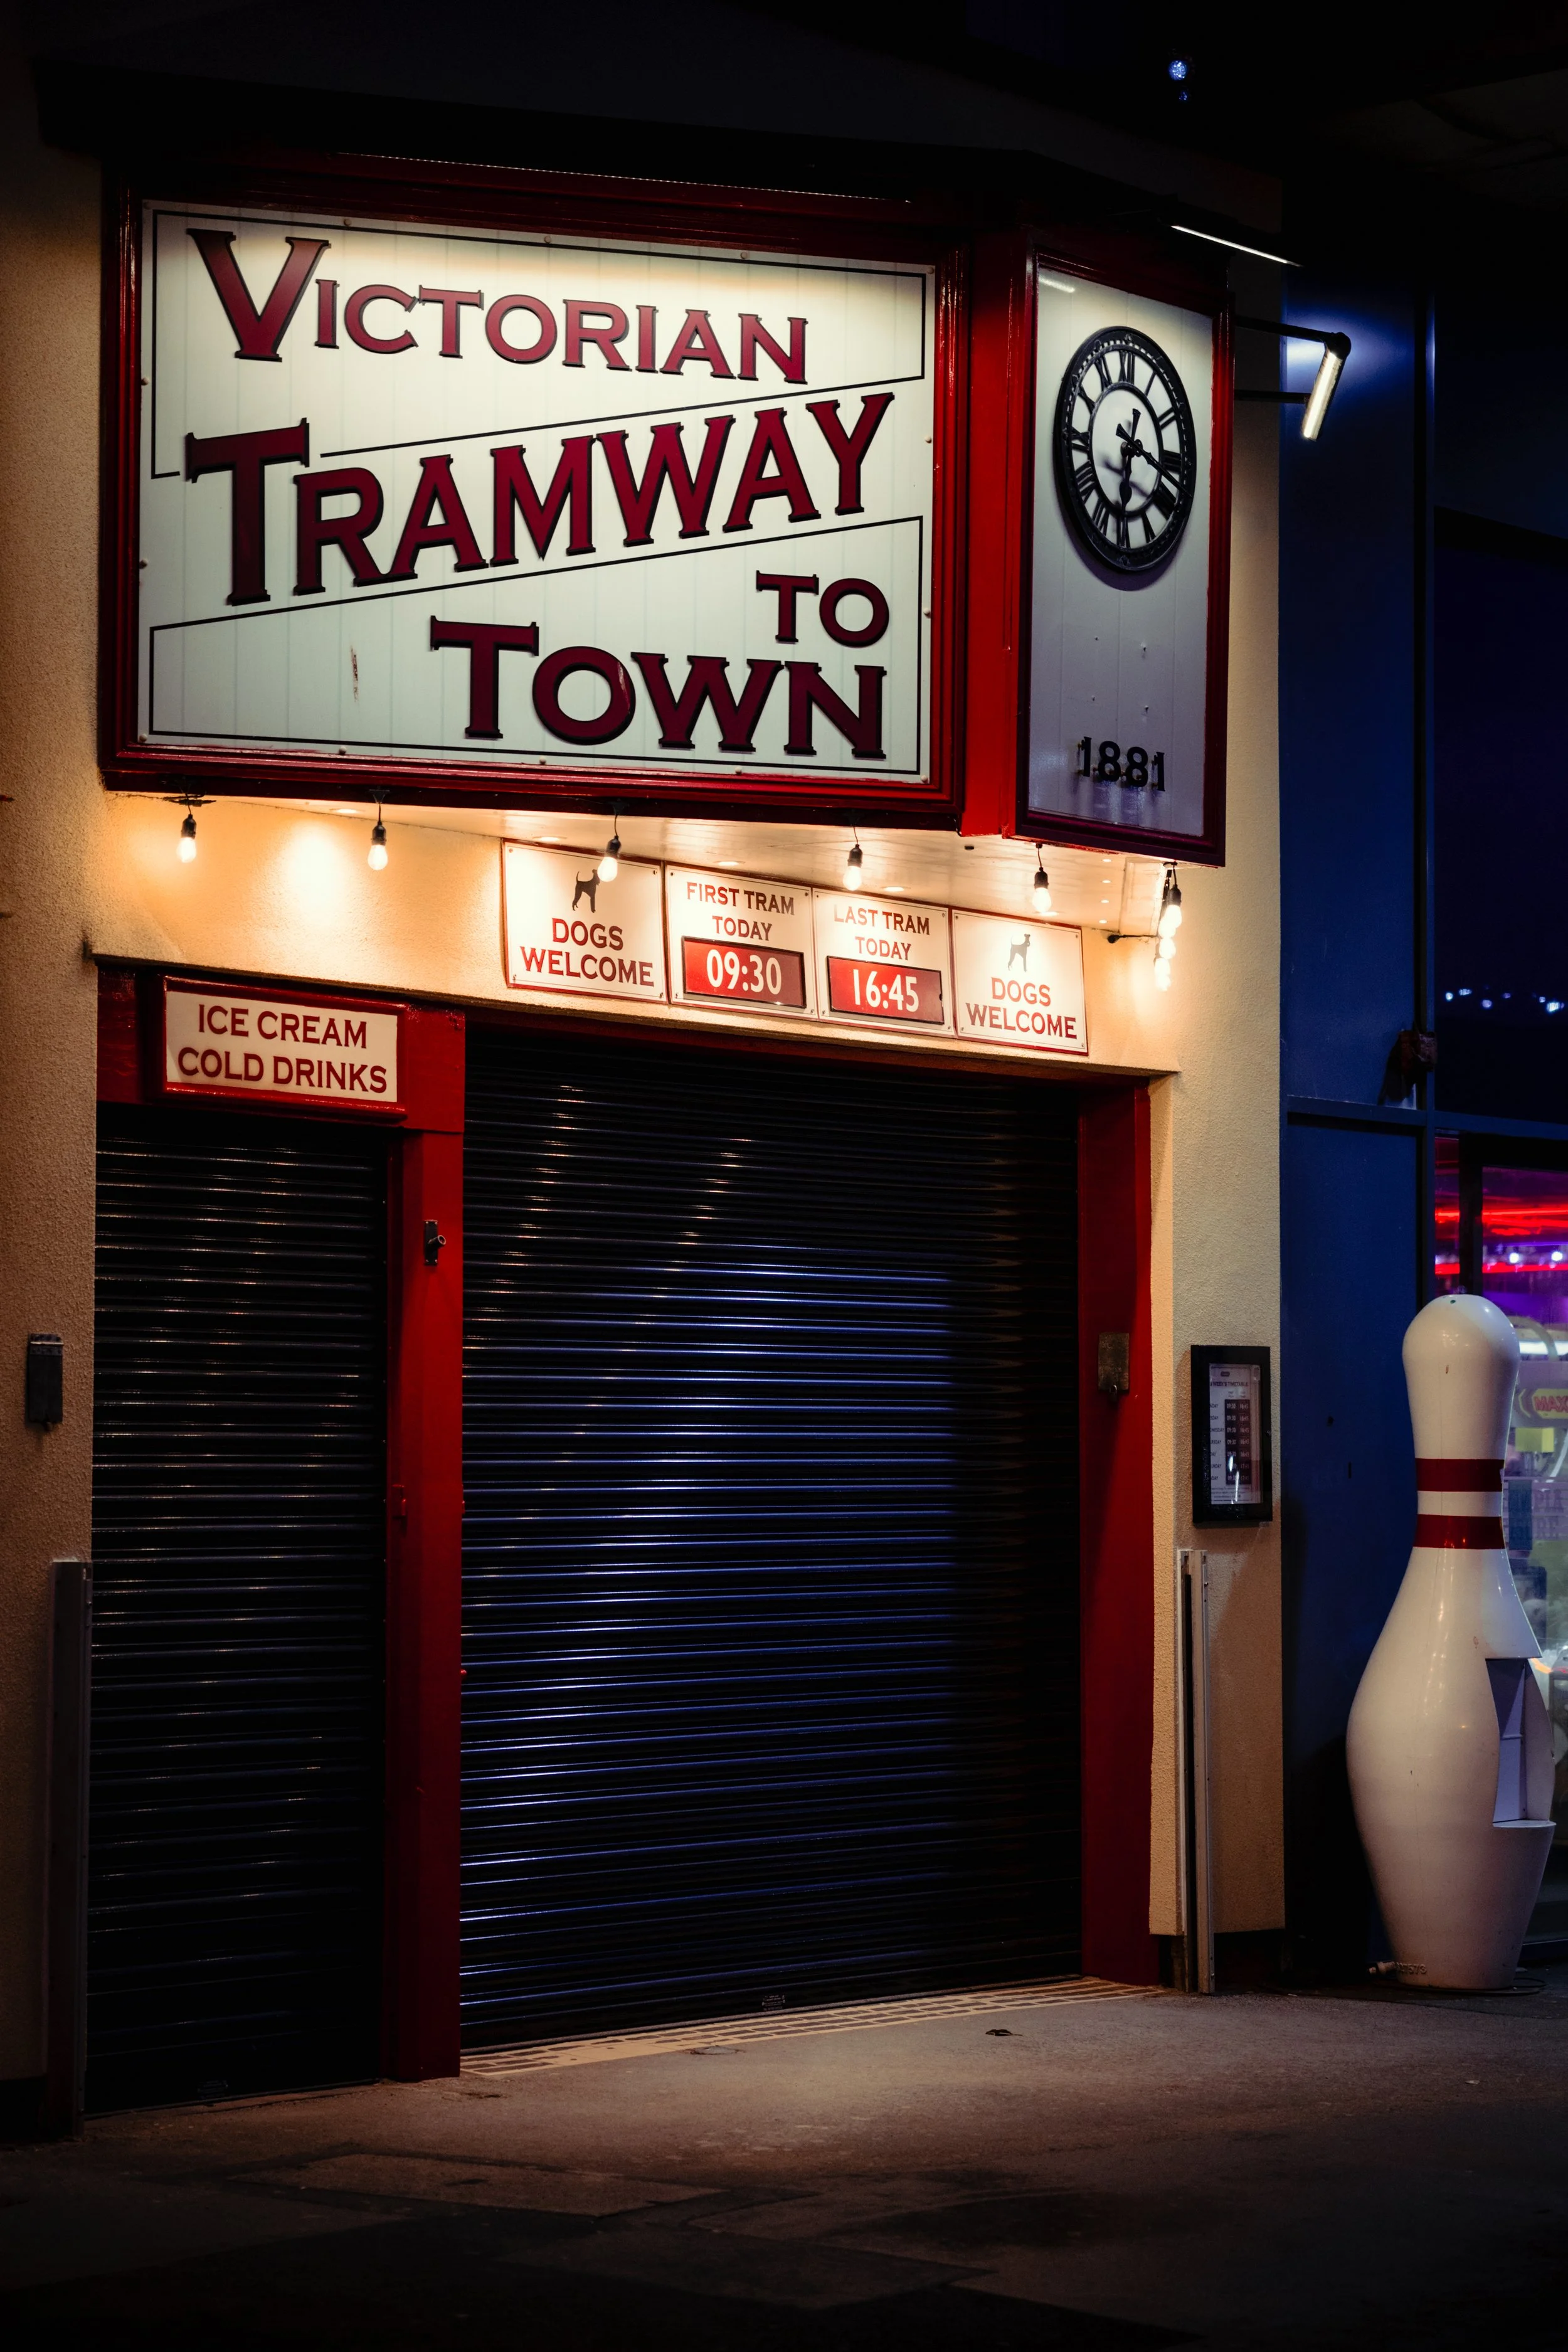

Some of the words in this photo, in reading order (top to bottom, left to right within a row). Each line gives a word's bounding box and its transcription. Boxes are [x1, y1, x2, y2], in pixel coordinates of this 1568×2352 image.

[186, 228, 808, 384] VICTORIAN
[185, 392, 895, 606] TRAMWAY
[756, 570, 889, 649] TO
[430, 615, 887, 760] TOWN
[1080, 736, 1165, 792] 1881
[686, 882, 739, 906] FIRST
[744, 890, 795, 915] TRAM
[834, 904, 878, 927] LAST
[882, 911, 930, 935] TRAM
[551, 918, 624, 951] DOGS
[712, 915, 773, 941] TODAY
[855, 936, 912, 960] TODAY
[520, 946, 654, 987] WELCOME
[706, 949, 782, 995] 09:30
[852, 968, 919, 1012] 16:45
[991, 977, 1051, 1007] DOGS
[198, 1004, 249, 1037] ICE
[257, 1010, 367, 1049] CREAM
[965, 1002, 1078, 1040] WELCOME
[177, 1047, 264, 1081] COLD
[273, 1056, 387, 1094] DRINKS
